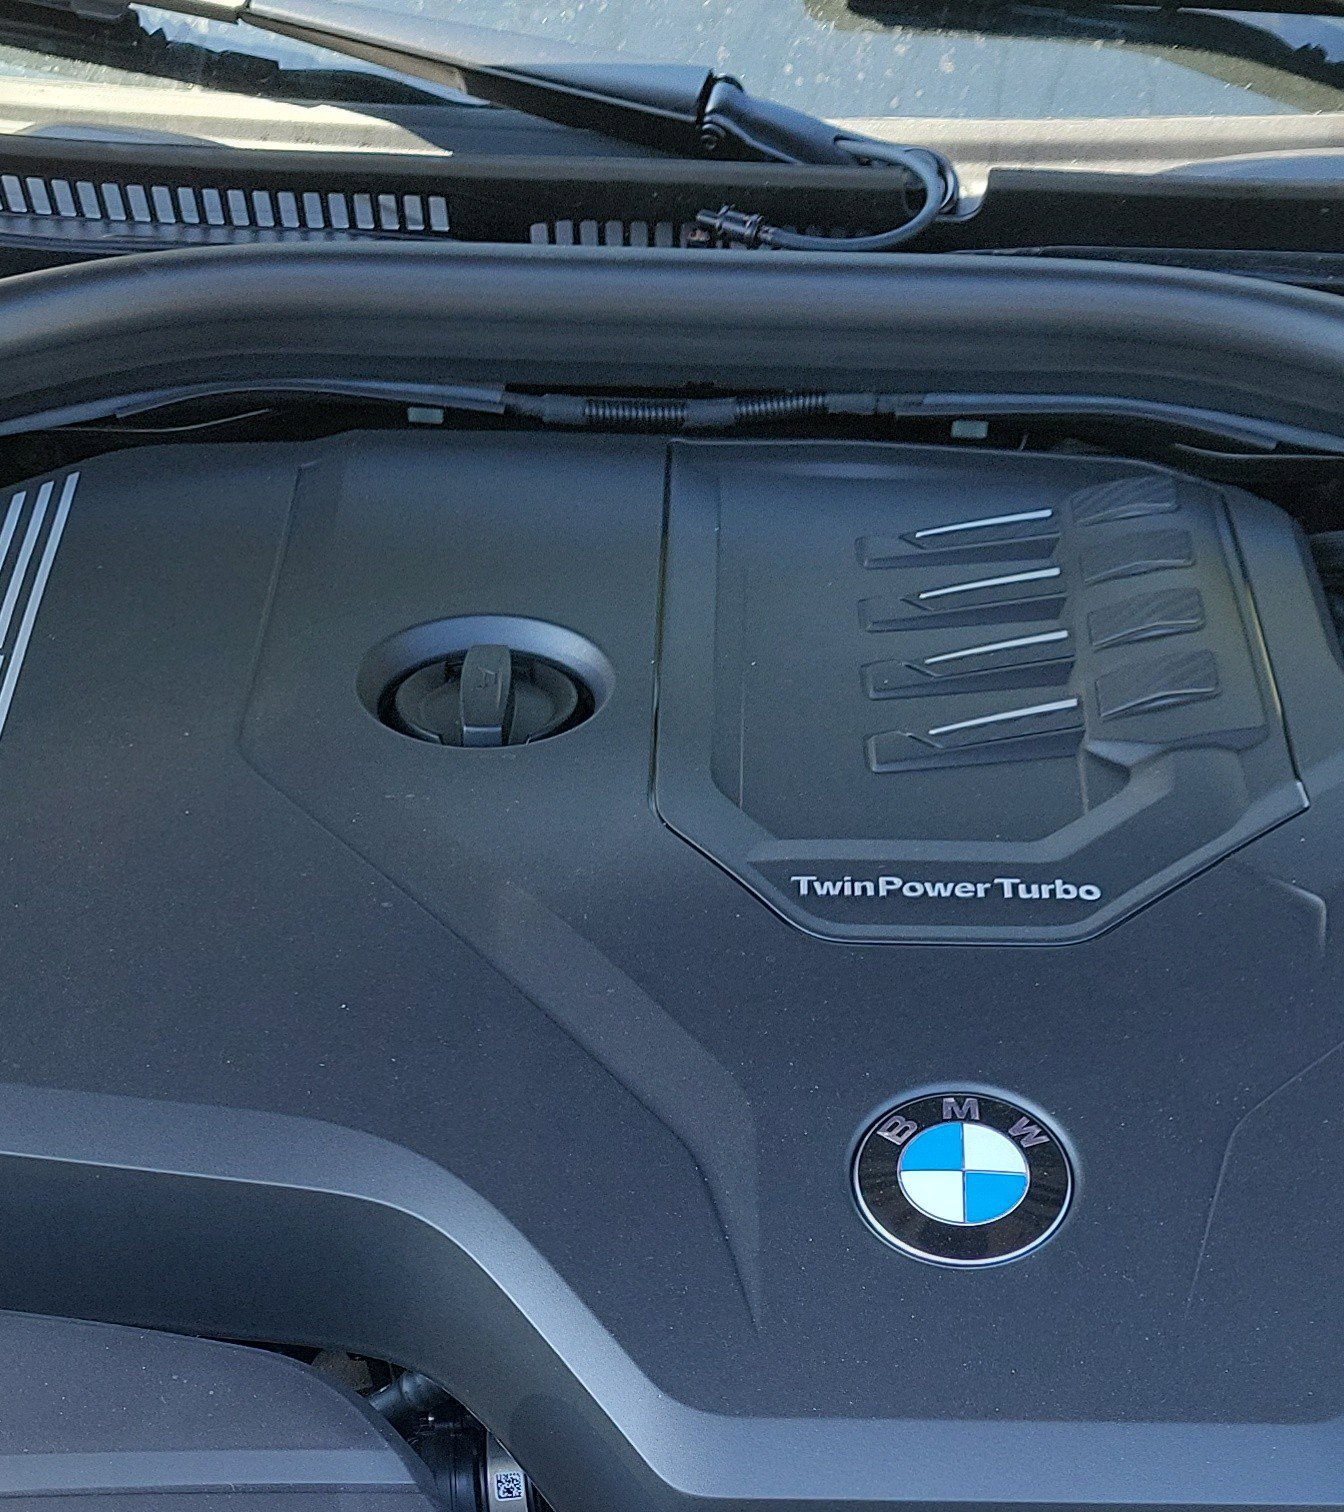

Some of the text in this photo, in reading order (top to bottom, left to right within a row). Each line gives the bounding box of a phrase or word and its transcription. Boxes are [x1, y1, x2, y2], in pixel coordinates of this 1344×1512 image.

[790, 875, 1102, 901] TwinPower Turbo
[876, 1097, 1051, 1149] BMW
